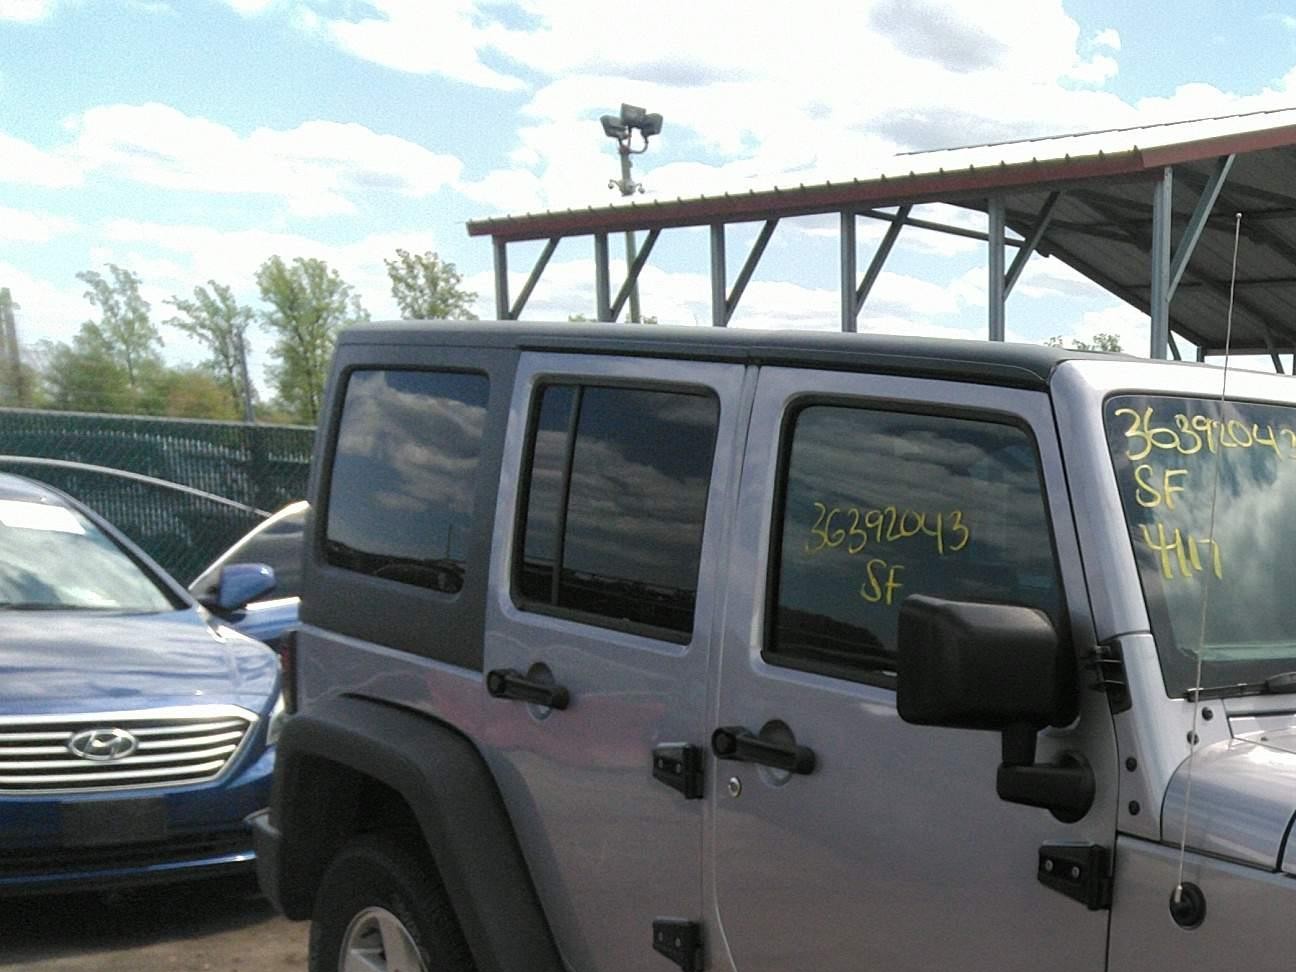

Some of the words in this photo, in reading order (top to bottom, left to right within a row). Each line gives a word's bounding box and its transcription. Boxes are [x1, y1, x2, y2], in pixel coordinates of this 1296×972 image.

[1134, 464, 1188, 510] SF
[805, 502, 970, 555] 36392043
[860, 559, 905, 605] SF
